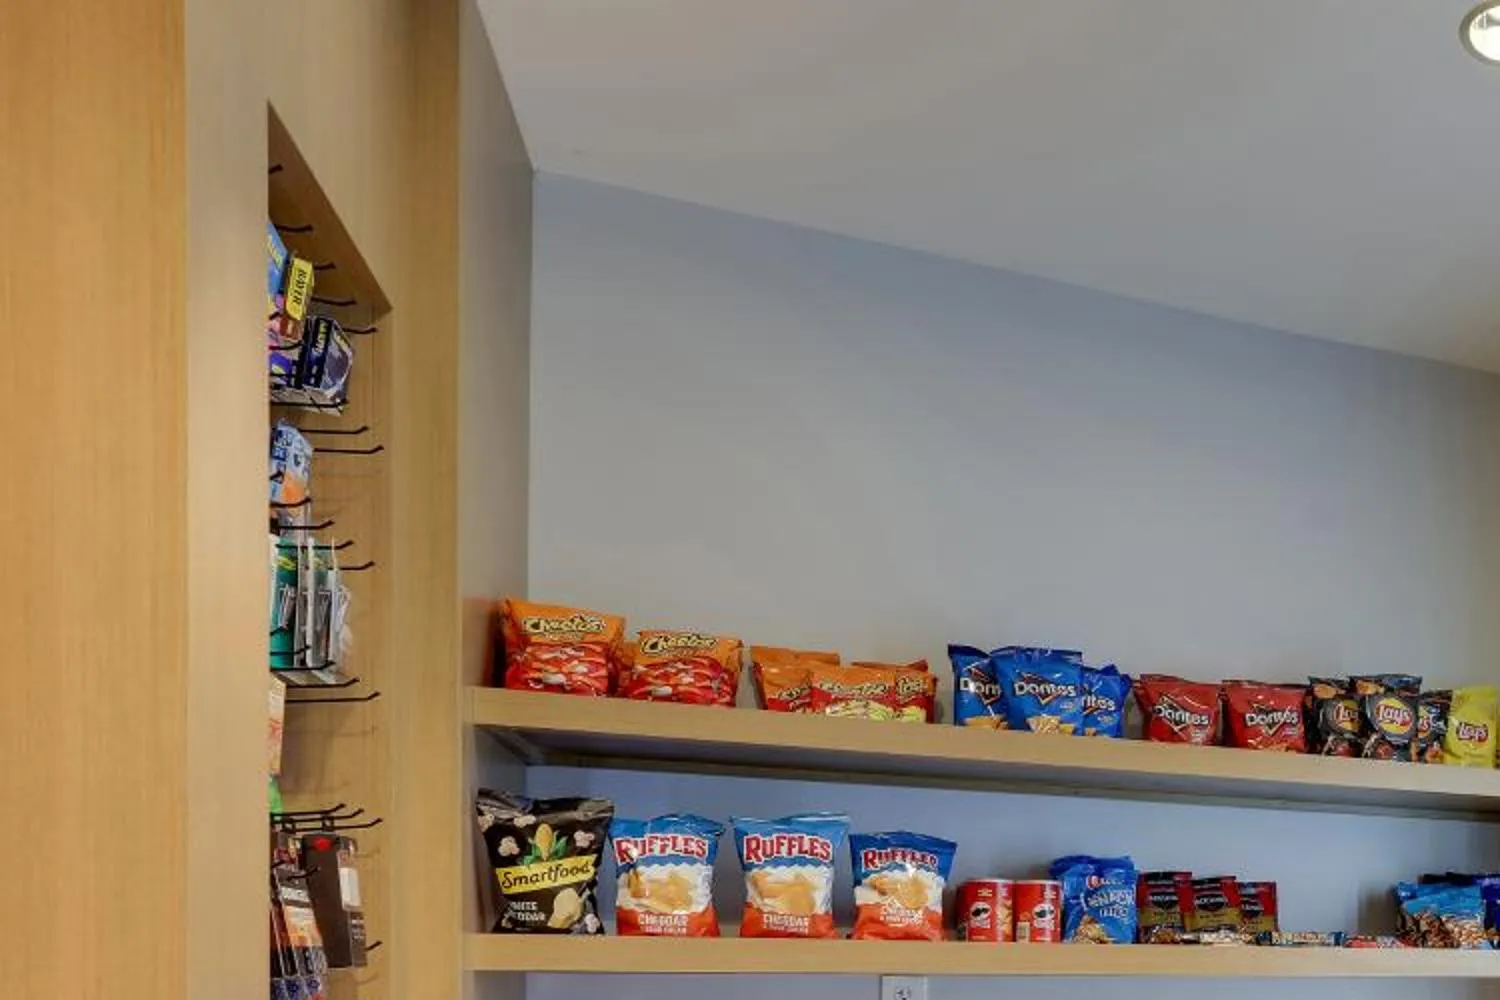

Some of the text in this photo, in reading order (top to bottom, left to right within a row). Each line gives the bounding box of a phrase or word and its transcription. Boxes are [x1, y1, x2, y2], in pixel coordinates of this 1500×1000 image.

[1015, 681, 1077, 698] Doritos
[1154, 706, 1209, 726] Doritos
[1246, 707, 1298, 726] Doritos
[613, 833, 709, 865] RUFFLES
[743, 832, 833, 864] RUFFLES
[500, 862, 592, 890] Smartfood
